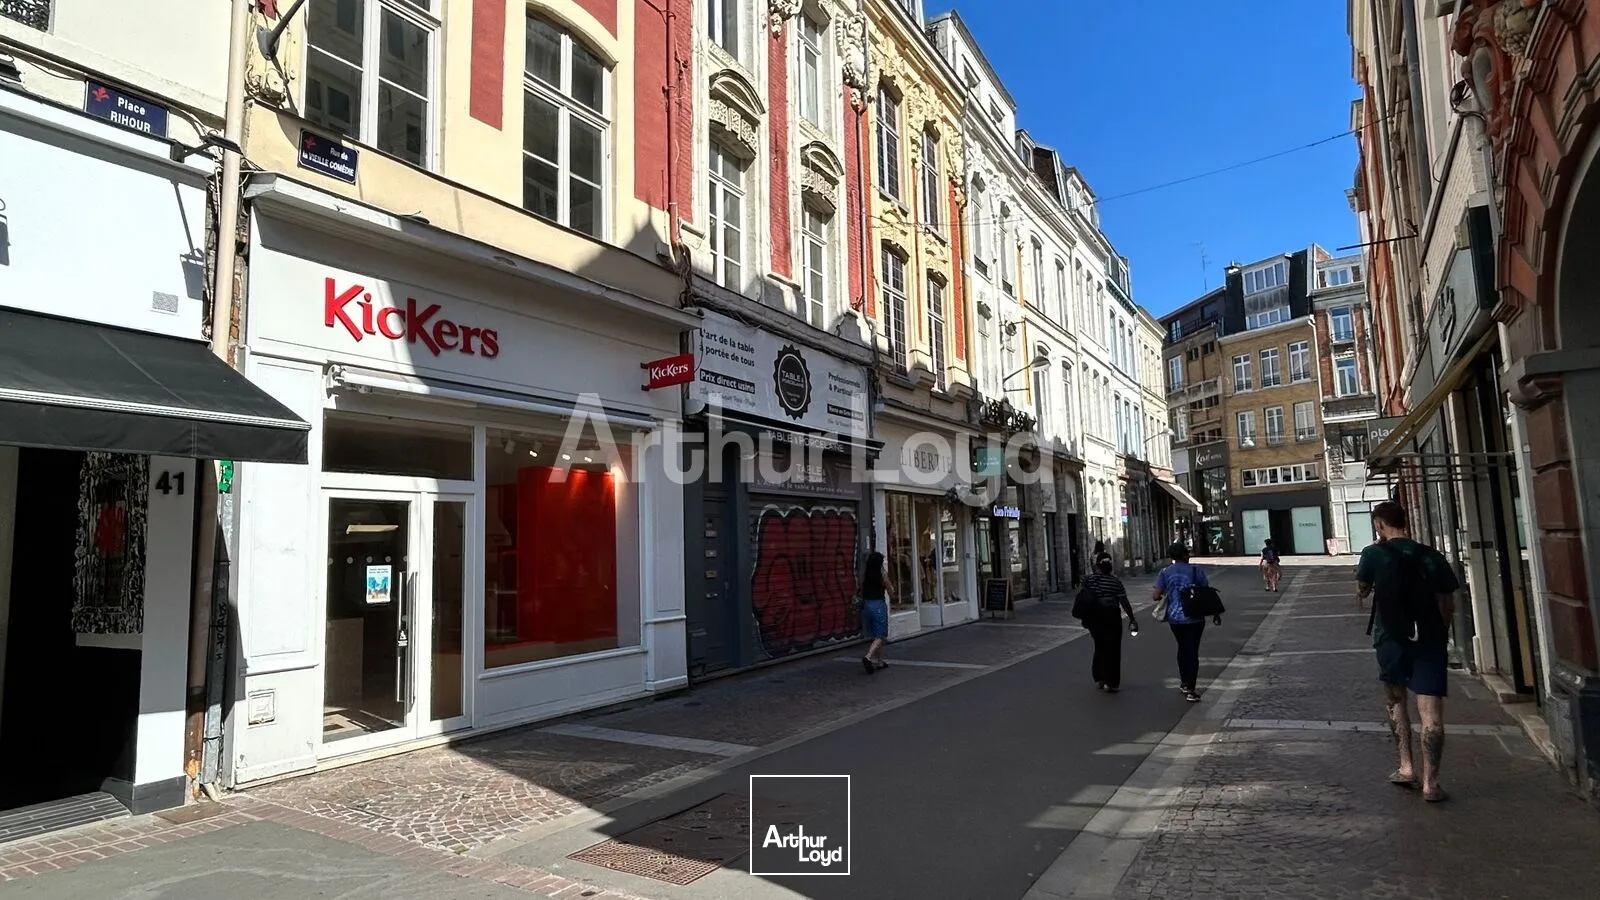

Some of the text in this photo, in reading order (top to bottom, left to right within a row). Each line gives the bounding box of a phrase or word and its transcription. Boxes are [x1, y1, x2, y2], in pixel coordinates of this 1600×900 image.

[117, 96, 146, 116] Place
[110, 110, 151, 132] RIHOUR
[330, 147, 349, 160] Rue de
[718, 335, 728, 345] de
[729, 337, 736, 348] la
[737, 341, 755, 354] table
[730, 352, 740, 362] de
[740, 357, 755, 367] tous
[701, 371, 716, 383] Prix
[716, 376, 737, 388] direct
[767, 430, 792, 442] TABLE
[155, 471, 184, 495] 41
